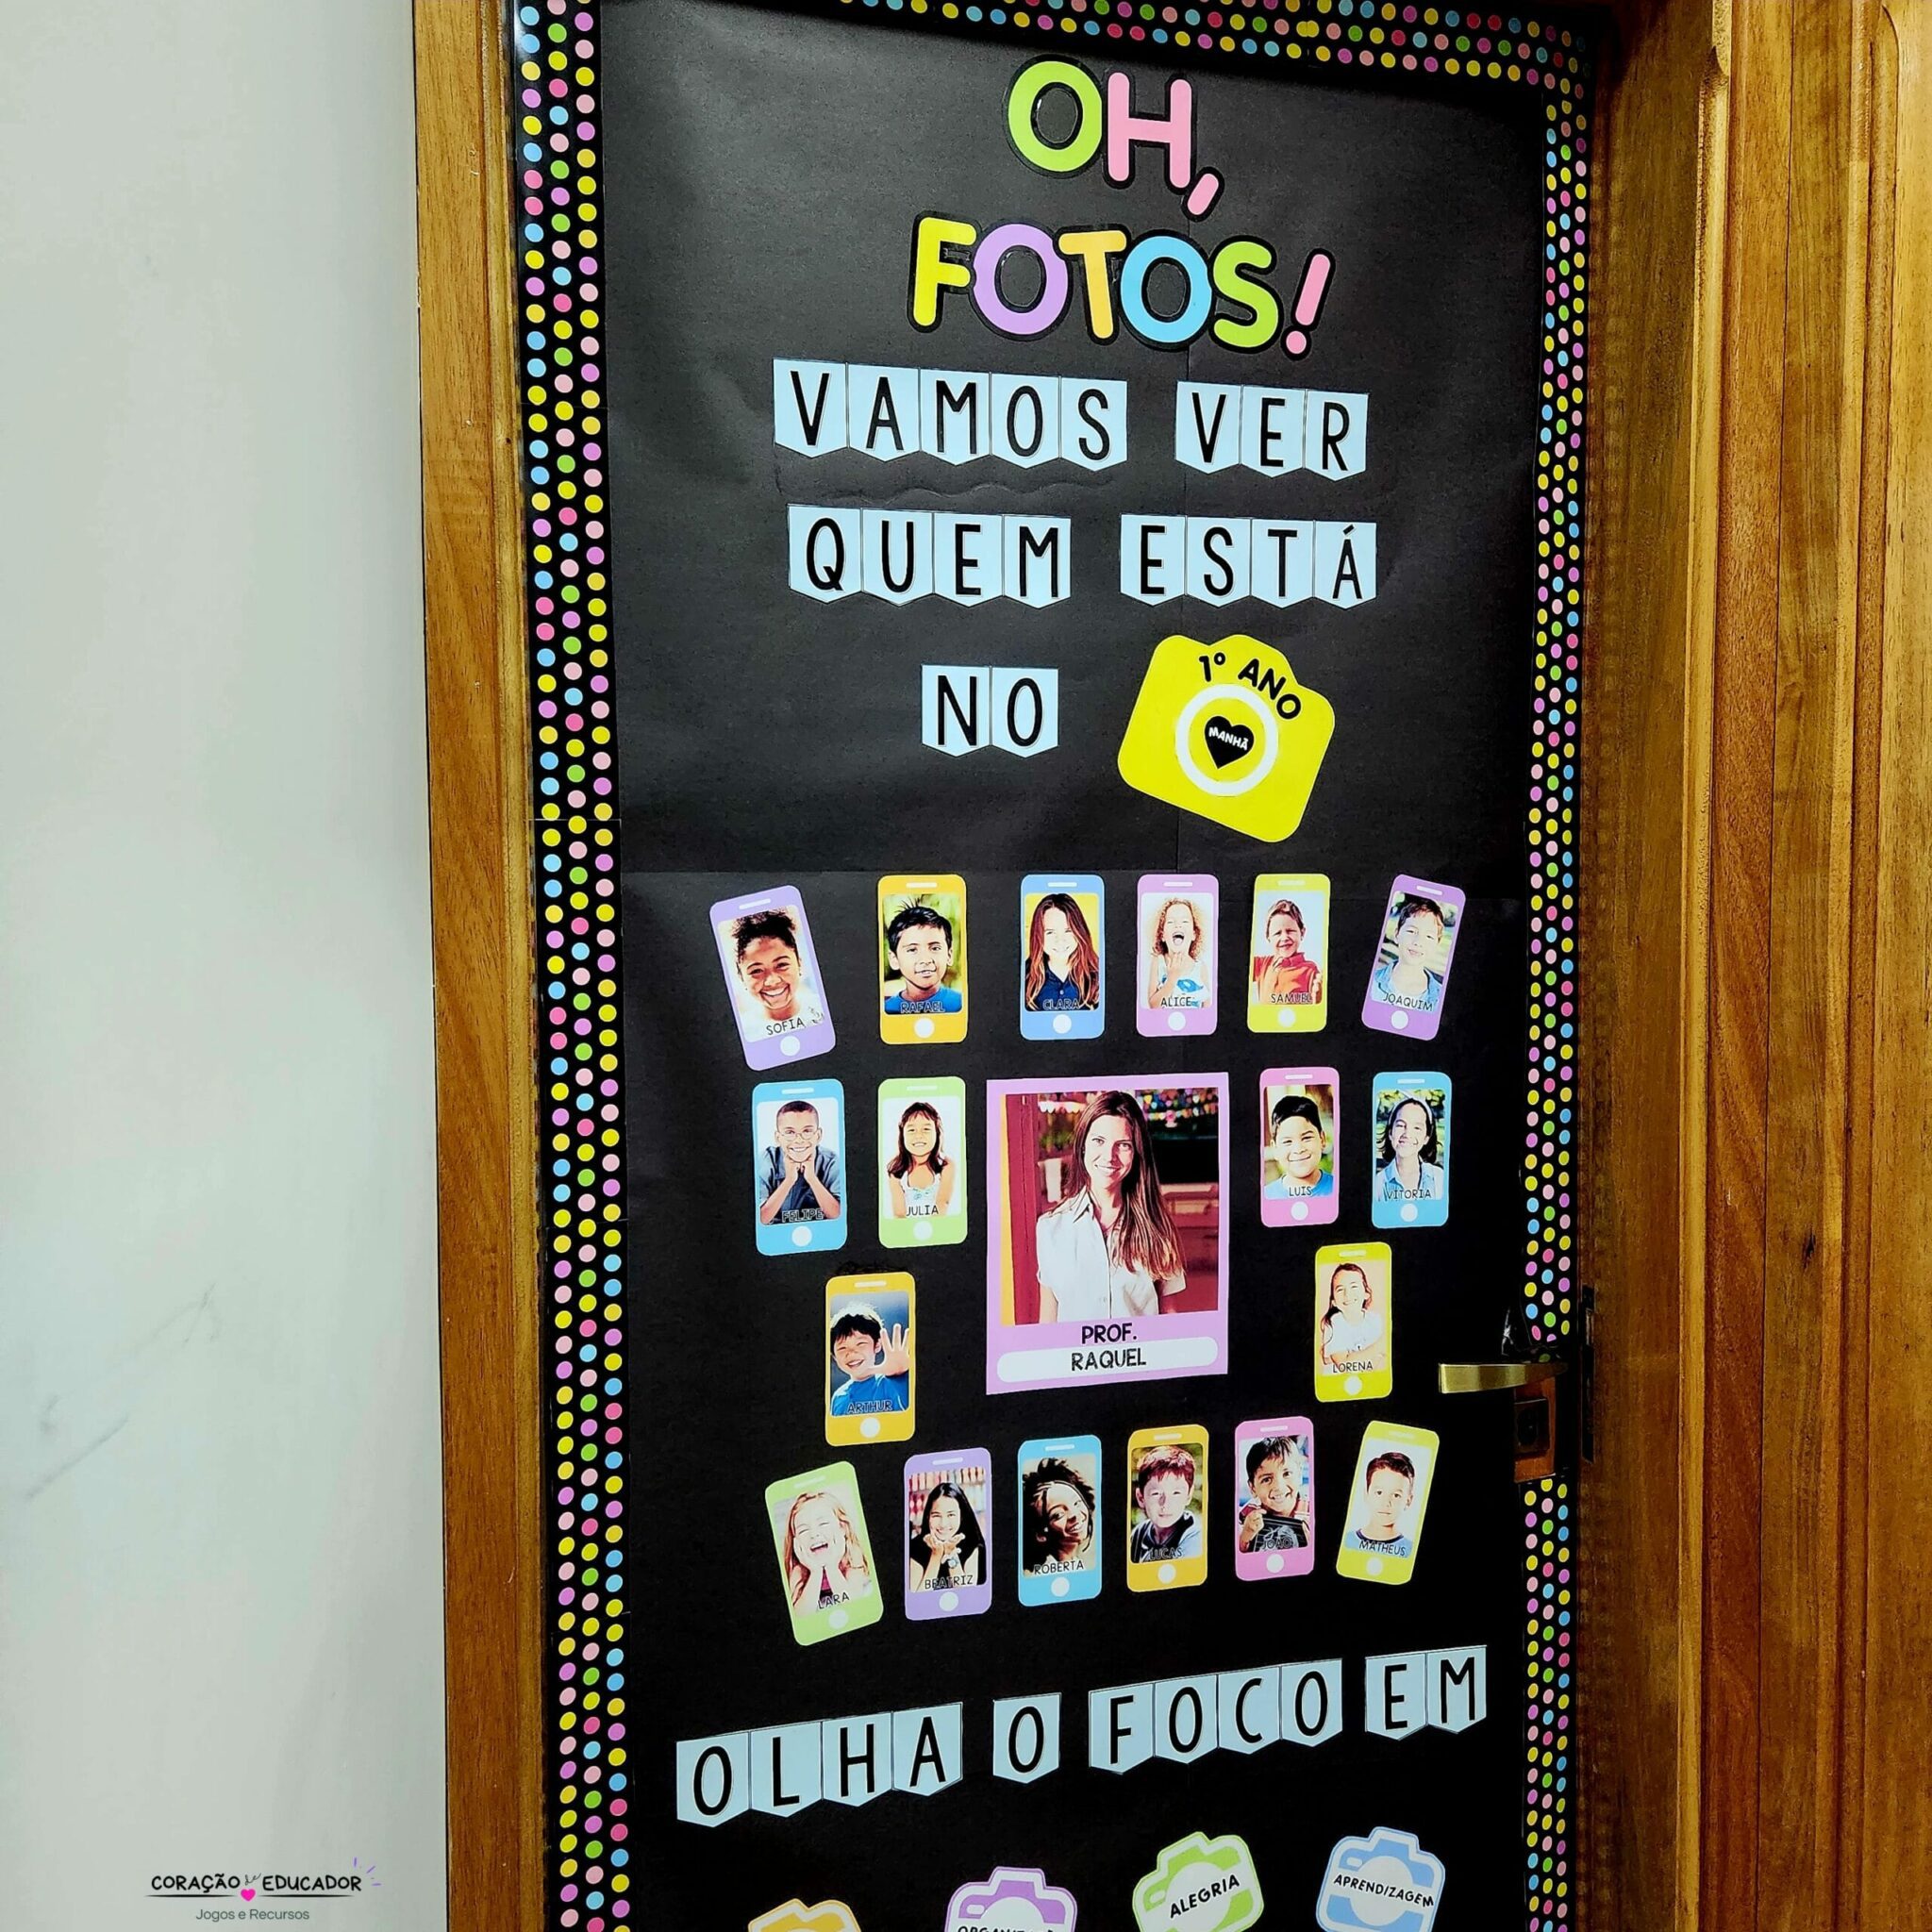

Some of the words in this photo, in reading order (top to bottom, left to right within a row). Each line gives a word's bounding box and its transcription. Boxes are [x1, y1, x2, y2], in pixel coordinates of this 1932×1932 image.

[1008, 59, 1220, 216] OH,
[912, 216, 1331, 355] FOTOS!
[790, 370, 1110, 460] VAMOS
[1191, 392, 1351, 472] VER
[806, 517, 1059, 599] QUEM
[1140, 525, 1361, 600] ESTÁ
[1238, 658, 1301, 720] ANO
[937, 675, 1042, 747] NO
[1208, 726, 1248, 751] MANHÃ
[901, 1001, 945, 1014] RAFAEL
[1042, 998, 1080, 1010] CLARA
[1160, 996, 1191, 1008] ALICE
[1271, 993, 1312, 1004] SAMUEL
[1382, 992, 1433, 1011] JOAQUIM
[765, 1018, 805, 1036] SOFIA
[1289, 1186, 1312, 1197] LUIS
[782, 1208, 824, 1223] FELIPE
[906, 1205, 939, 1216] JULIA
[1081, 1323, 1137, 1344] PROF.
[1071, 1348, 1146, 1371] RAQUEL
[1332, 1360, 1374, 1374] LORENA
[847, 1400, 892, 1414] ARTHUR
[1358, 1540, 1406, 1557] MATHEUS
[1034, 1559, 1084, 1575] ROBERTA
[924, 1574, 974, 1590] BEATRIZ
[818, 1591, 850, 1610] LARA
[693, 1716, 946, 1816] OLHA
[1008, 1706, 1044, 1774] O
[1109, 1670, 1328, 1764] FOCO
[1384, 1657, 1475, 1730] EM
[1170, 1874, 1241, 1919] ALEGRIA
[1333, 1874, 1434, 1907] APRENDIZAGEM
